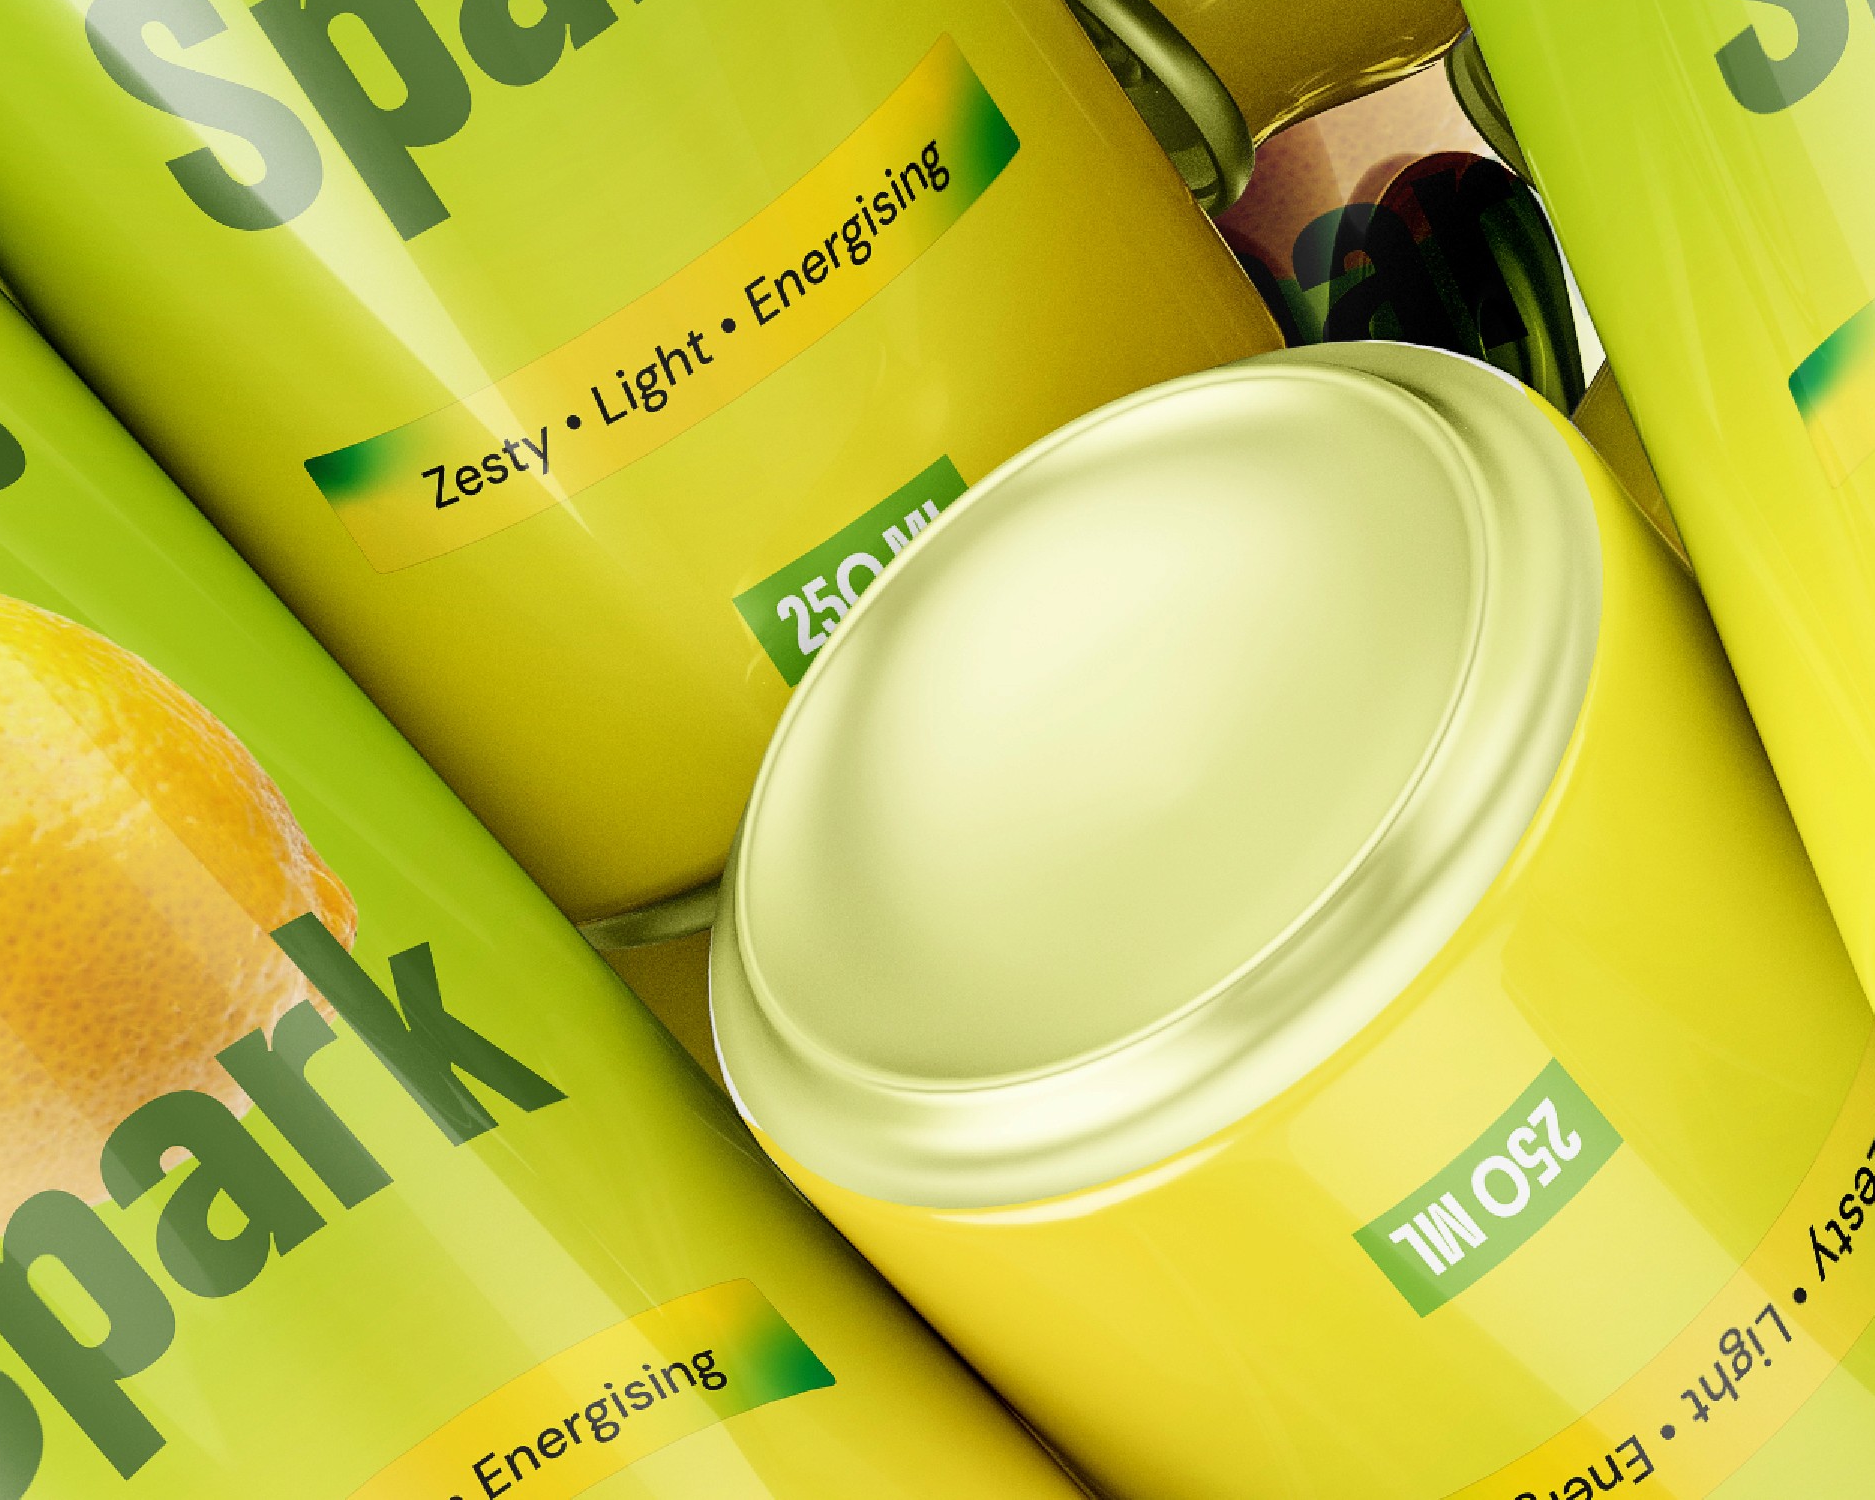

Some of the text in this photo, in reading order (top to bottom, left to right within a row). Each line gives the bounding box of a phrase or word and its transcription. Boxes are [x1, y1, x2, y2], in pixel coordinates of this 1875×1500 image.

[423, 138, 950, 510] Zesty Light Energising
[1387, 1099, 1582, 1277] 250 ML
[471, 1346, 726, 1498] Energising
[1678, 1303, 1792, 1422] Light
